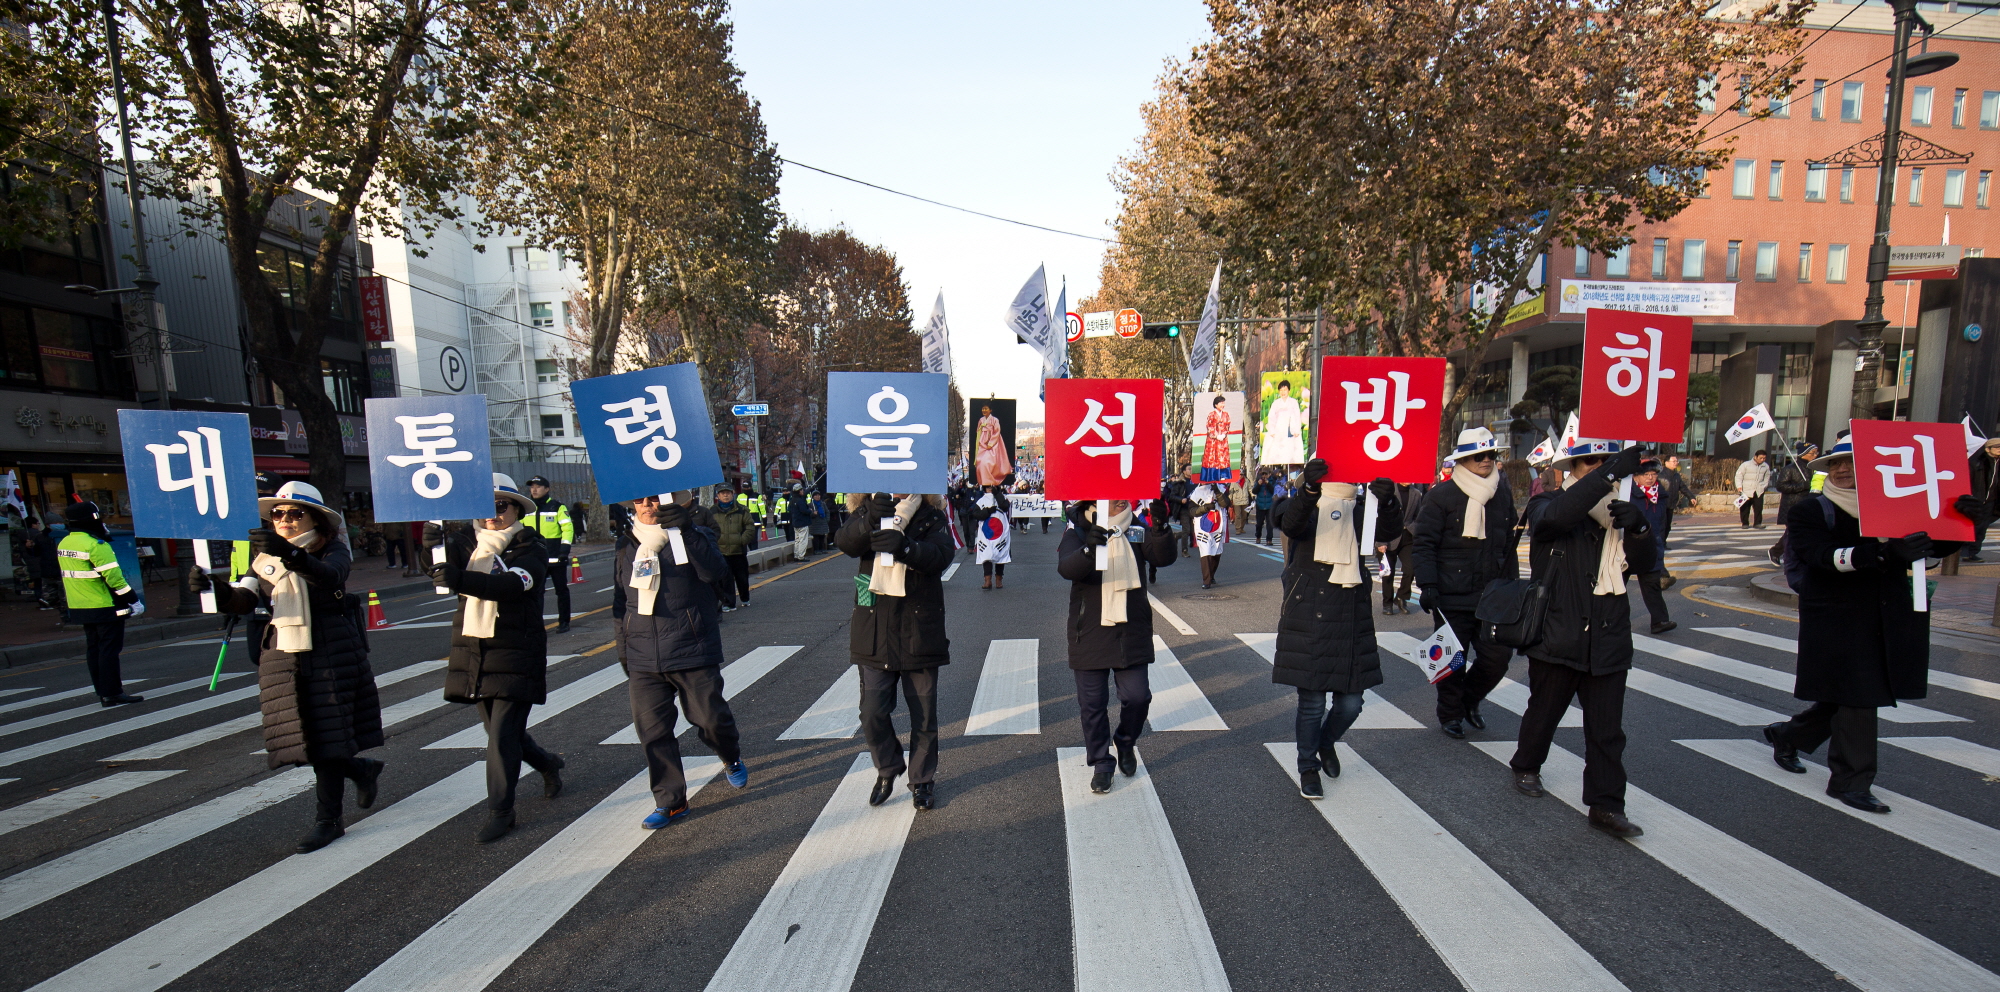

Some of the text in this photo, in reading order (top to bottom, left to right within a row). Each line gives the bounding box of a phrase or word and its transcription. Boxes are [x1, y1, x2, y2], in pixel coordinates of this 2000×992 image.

[366, 290, 385, 335] 삼계탕
[1119, 314, 1137, 325] 정지
[1119, 324, 1138, 334] STOP
[370, 355, 392, 365] OAK
[1602, 328, 1676, 419] 하
[49, 410, 109, 436] 국수나무
[386, 412, 473, 499] 통
[602, 386, 681, 470] 령
[844, 386, 930, 470] 을
[1065, 393, 1135, 478] 석
[1341, 372, 1425, 460] 방
[145, 427, 229, 519] 대
[1874, 435, 1954, 519] 라
